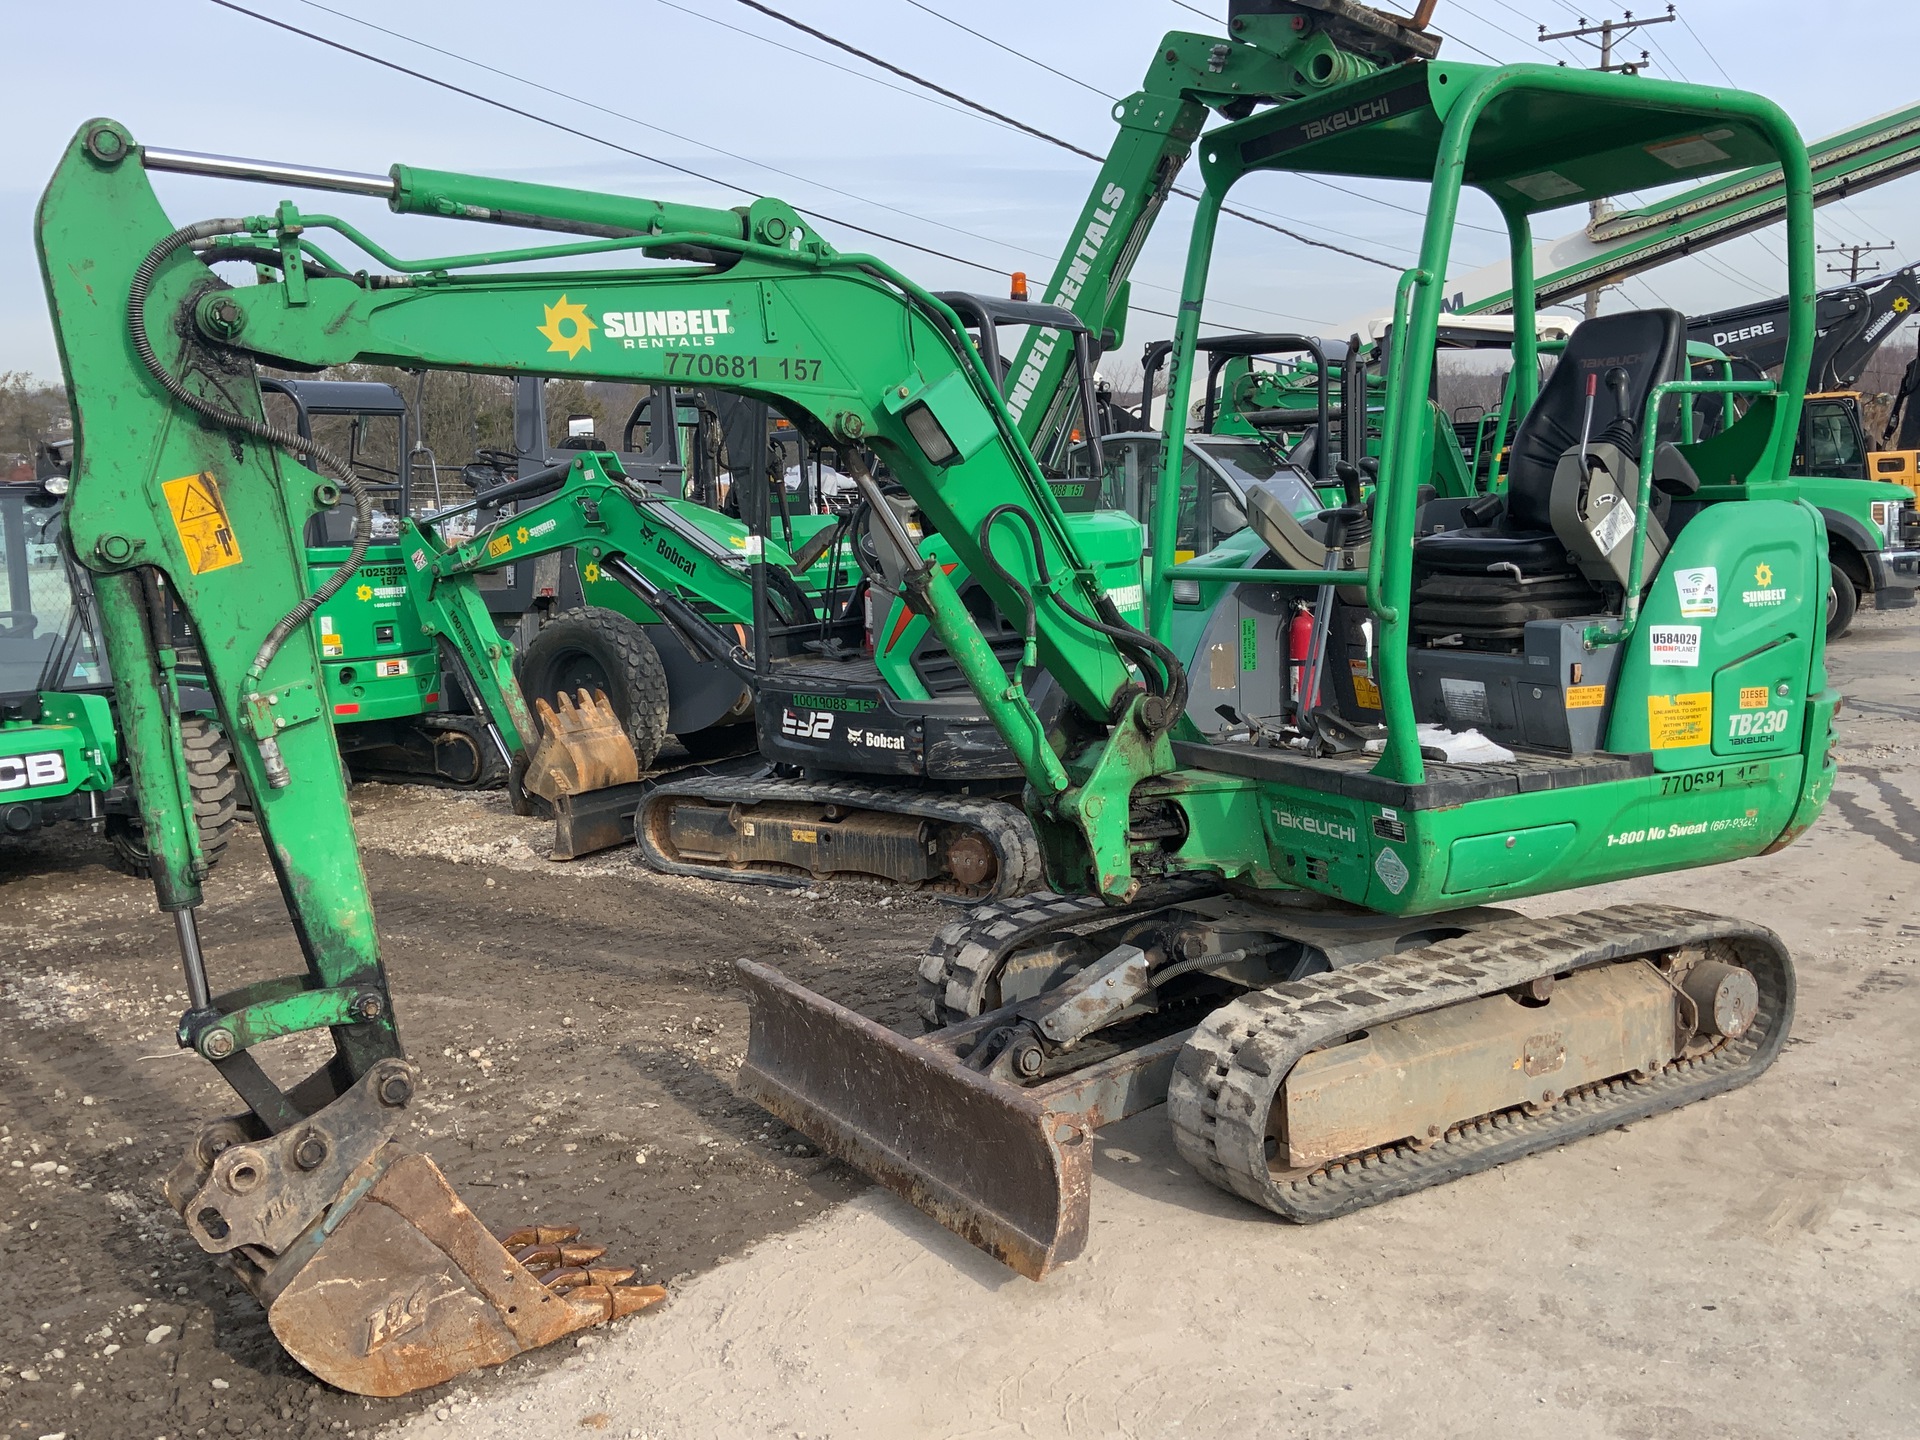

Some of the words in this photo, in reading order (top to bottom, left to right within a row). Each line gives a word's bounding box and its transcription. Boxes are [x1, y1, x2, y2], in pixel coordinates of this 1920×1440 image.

[1300, 97, 1390, 140] TAKEUCHI
[602, 308, 731, 339] SUNBELT
[1713, 321, 1775, 347] DEERE
[623, 335, 716, 349] RENTALS
[665, 352, 759, 379] 770681
[778, 358, 823, 382] 157
[1006, 326, 1061, 425] UNBELT
[1165, 330, 1184, 411] 770681
[1071, 484, 1085, 495] 157
[656, 538, 698, 578] Bobcat
[373, 586, 407, 596] SUNBELT
[381, 577, 398, 585] 157
[1742, 588, 1787, 603] SUNBELT
[1652, 633, 1697, 645] U584029
[793, 694, 848, 711] 10019088
[1741, 689, 1768, 699] DIESEL
[1728, 709, 1788, 737] TB230
[865, 732, 906, 750] Bobcat
[1729, 734, 1775, 746] TAKEUCHI
[0, 753, 65, 790] CB
[1272, 809, 1356, 843] TAKEUCHI
[1607, 830, 1644, 847] 1-800
[1646, 827, 1666, 841] No
[1668, 821, 1708, 838] Sweat
